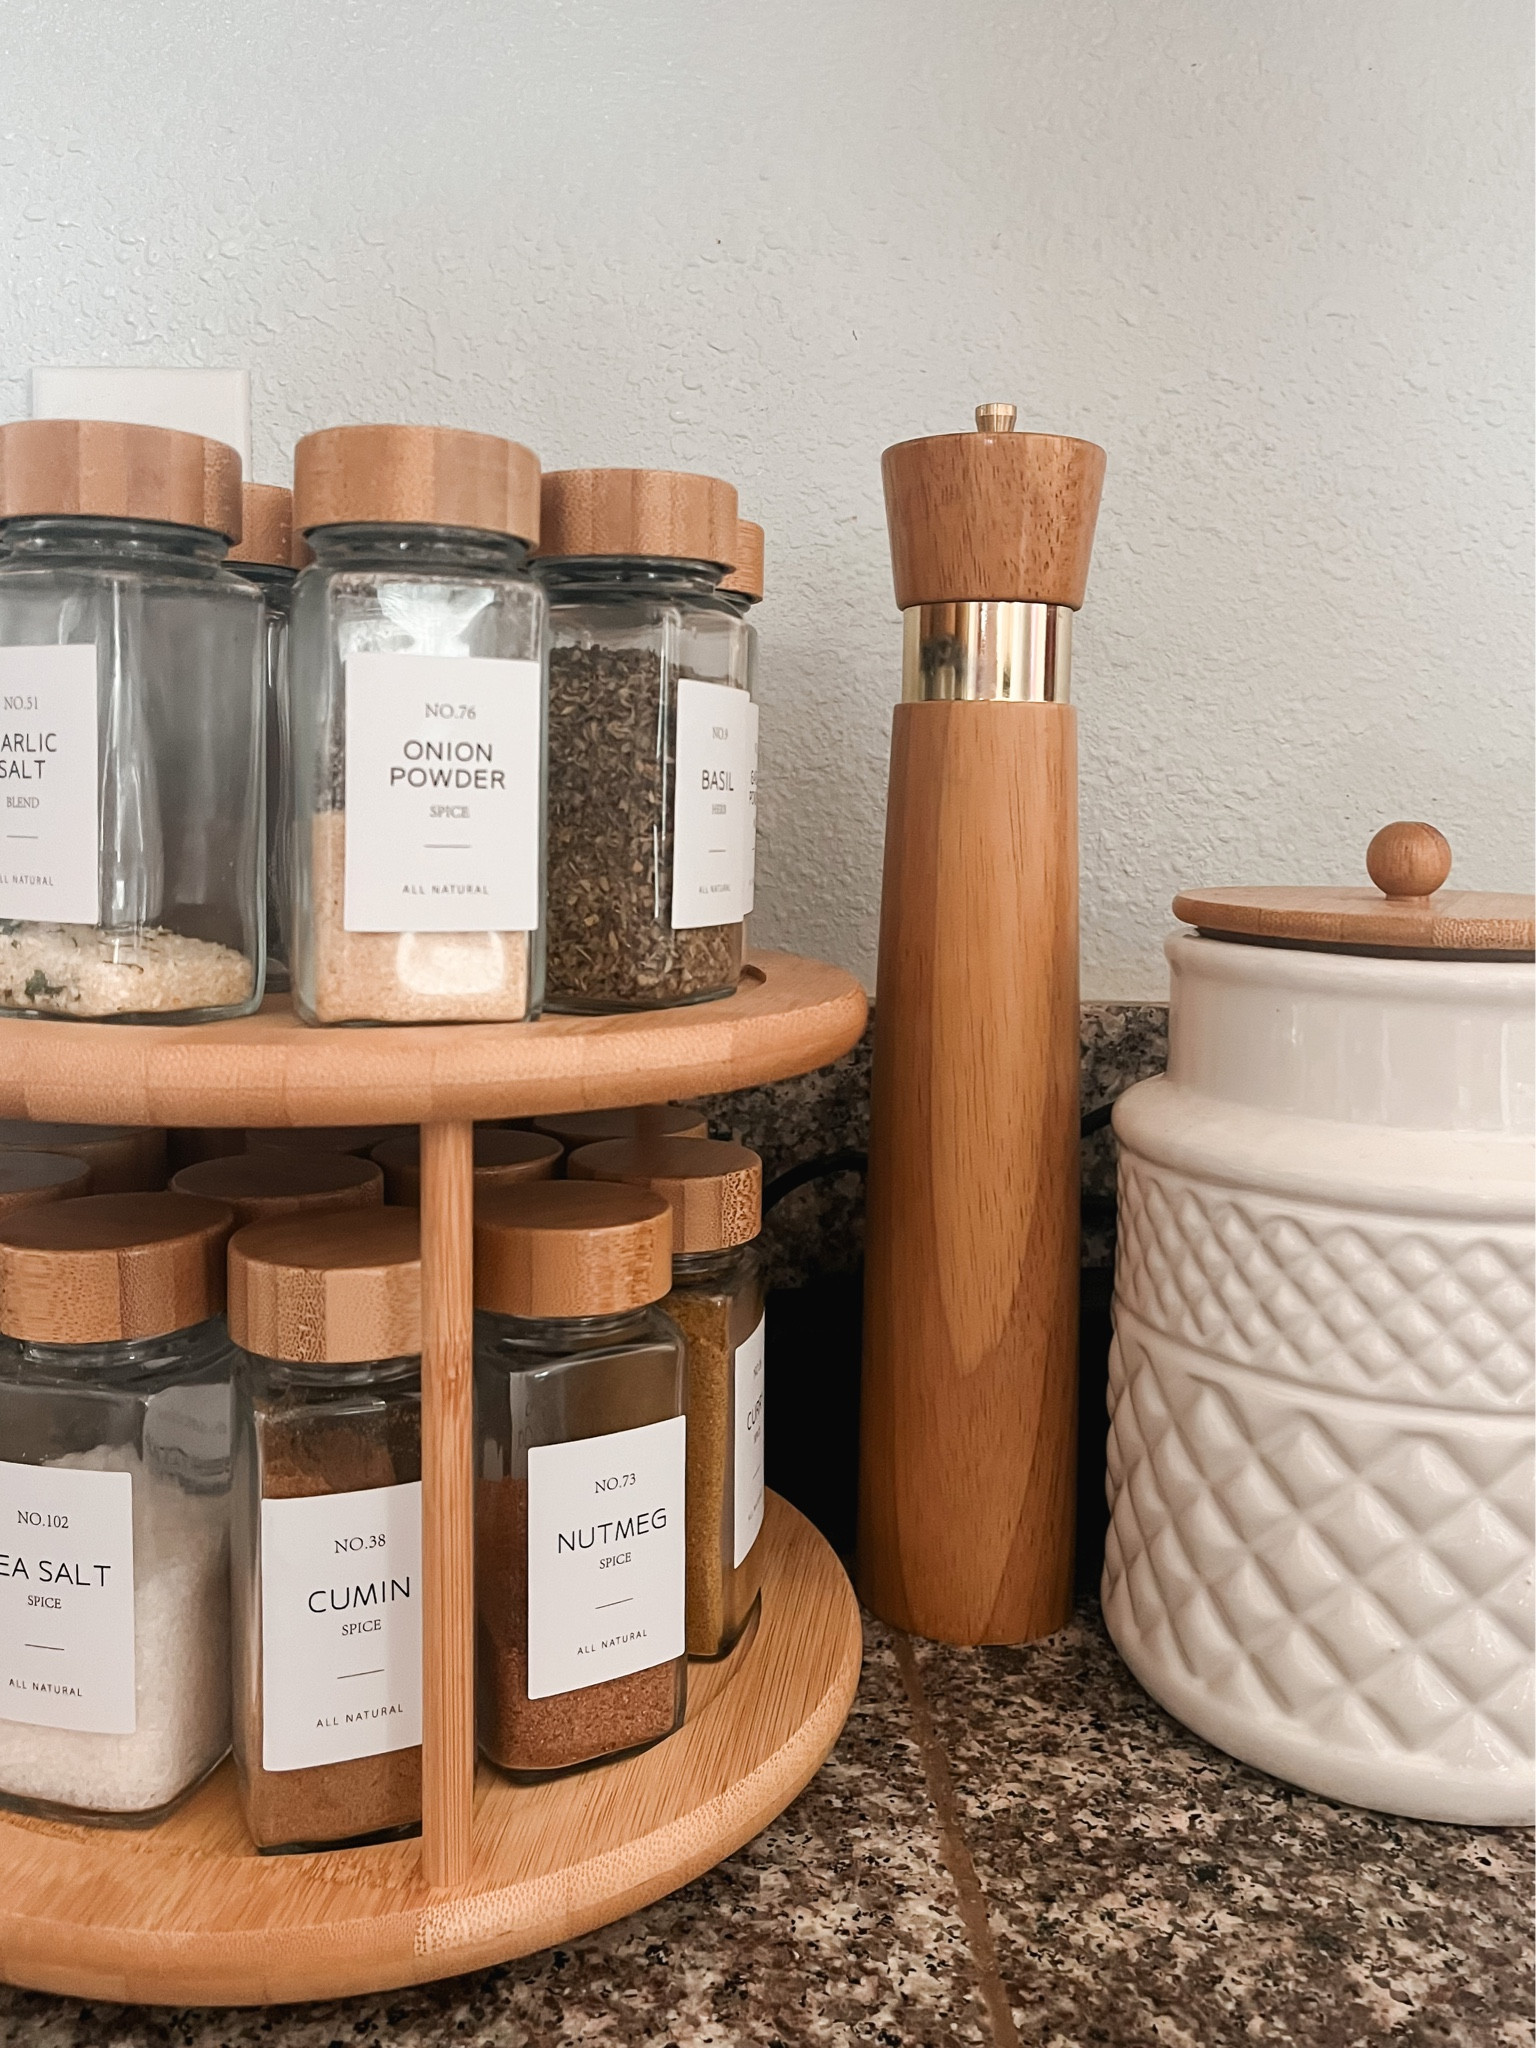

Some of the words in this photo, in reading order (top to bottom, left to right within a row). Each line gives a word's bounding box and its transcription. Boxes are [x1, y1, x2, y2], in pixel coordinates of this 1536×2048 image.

[4, 696, 38, 711] NO.51
[424, 703, 477, 720] NO.76
[403, 739, 493, 763] ONION
[0, 759, 46, 780] SALT
[390, 766, 506, 790] POWDER
[701, 769, 735, 792] BASIL
[6, 796, 40, 809] BLEND
[429, 805, 471, 819] SPICE
[12, 875, 54, 887] NATURAL
[402, 884, 425, 895] ALL
[431, 884, 489, 896] NATURAL
[594, 1472, 637, 1494] NO.73
[17, 1510, 69, 1529] NO.102
[557, 1507, 668, 1554] NUTMEG
[334, 1533, 387, 1554] NO.38
[599, 1551, 632, 1570] SPICE
[39, 1560, 111, 1587] SALT
[27, 1594, 62, 1610] SPICE
[308, 1576, 411, 1613] CUMIN
[341, 1618, 382, 1636] SPICE
[577, 1643, 596, 1656] ALL
[601, 1628, 648, 1649] NATURAL
[8, 1678, 27, 1690] ALL
[32, 1681, 83, 1697] NATURAL
[316, 1716, 339, 1728] ALL
[345, 1703, 404, 1724] NATURAL
